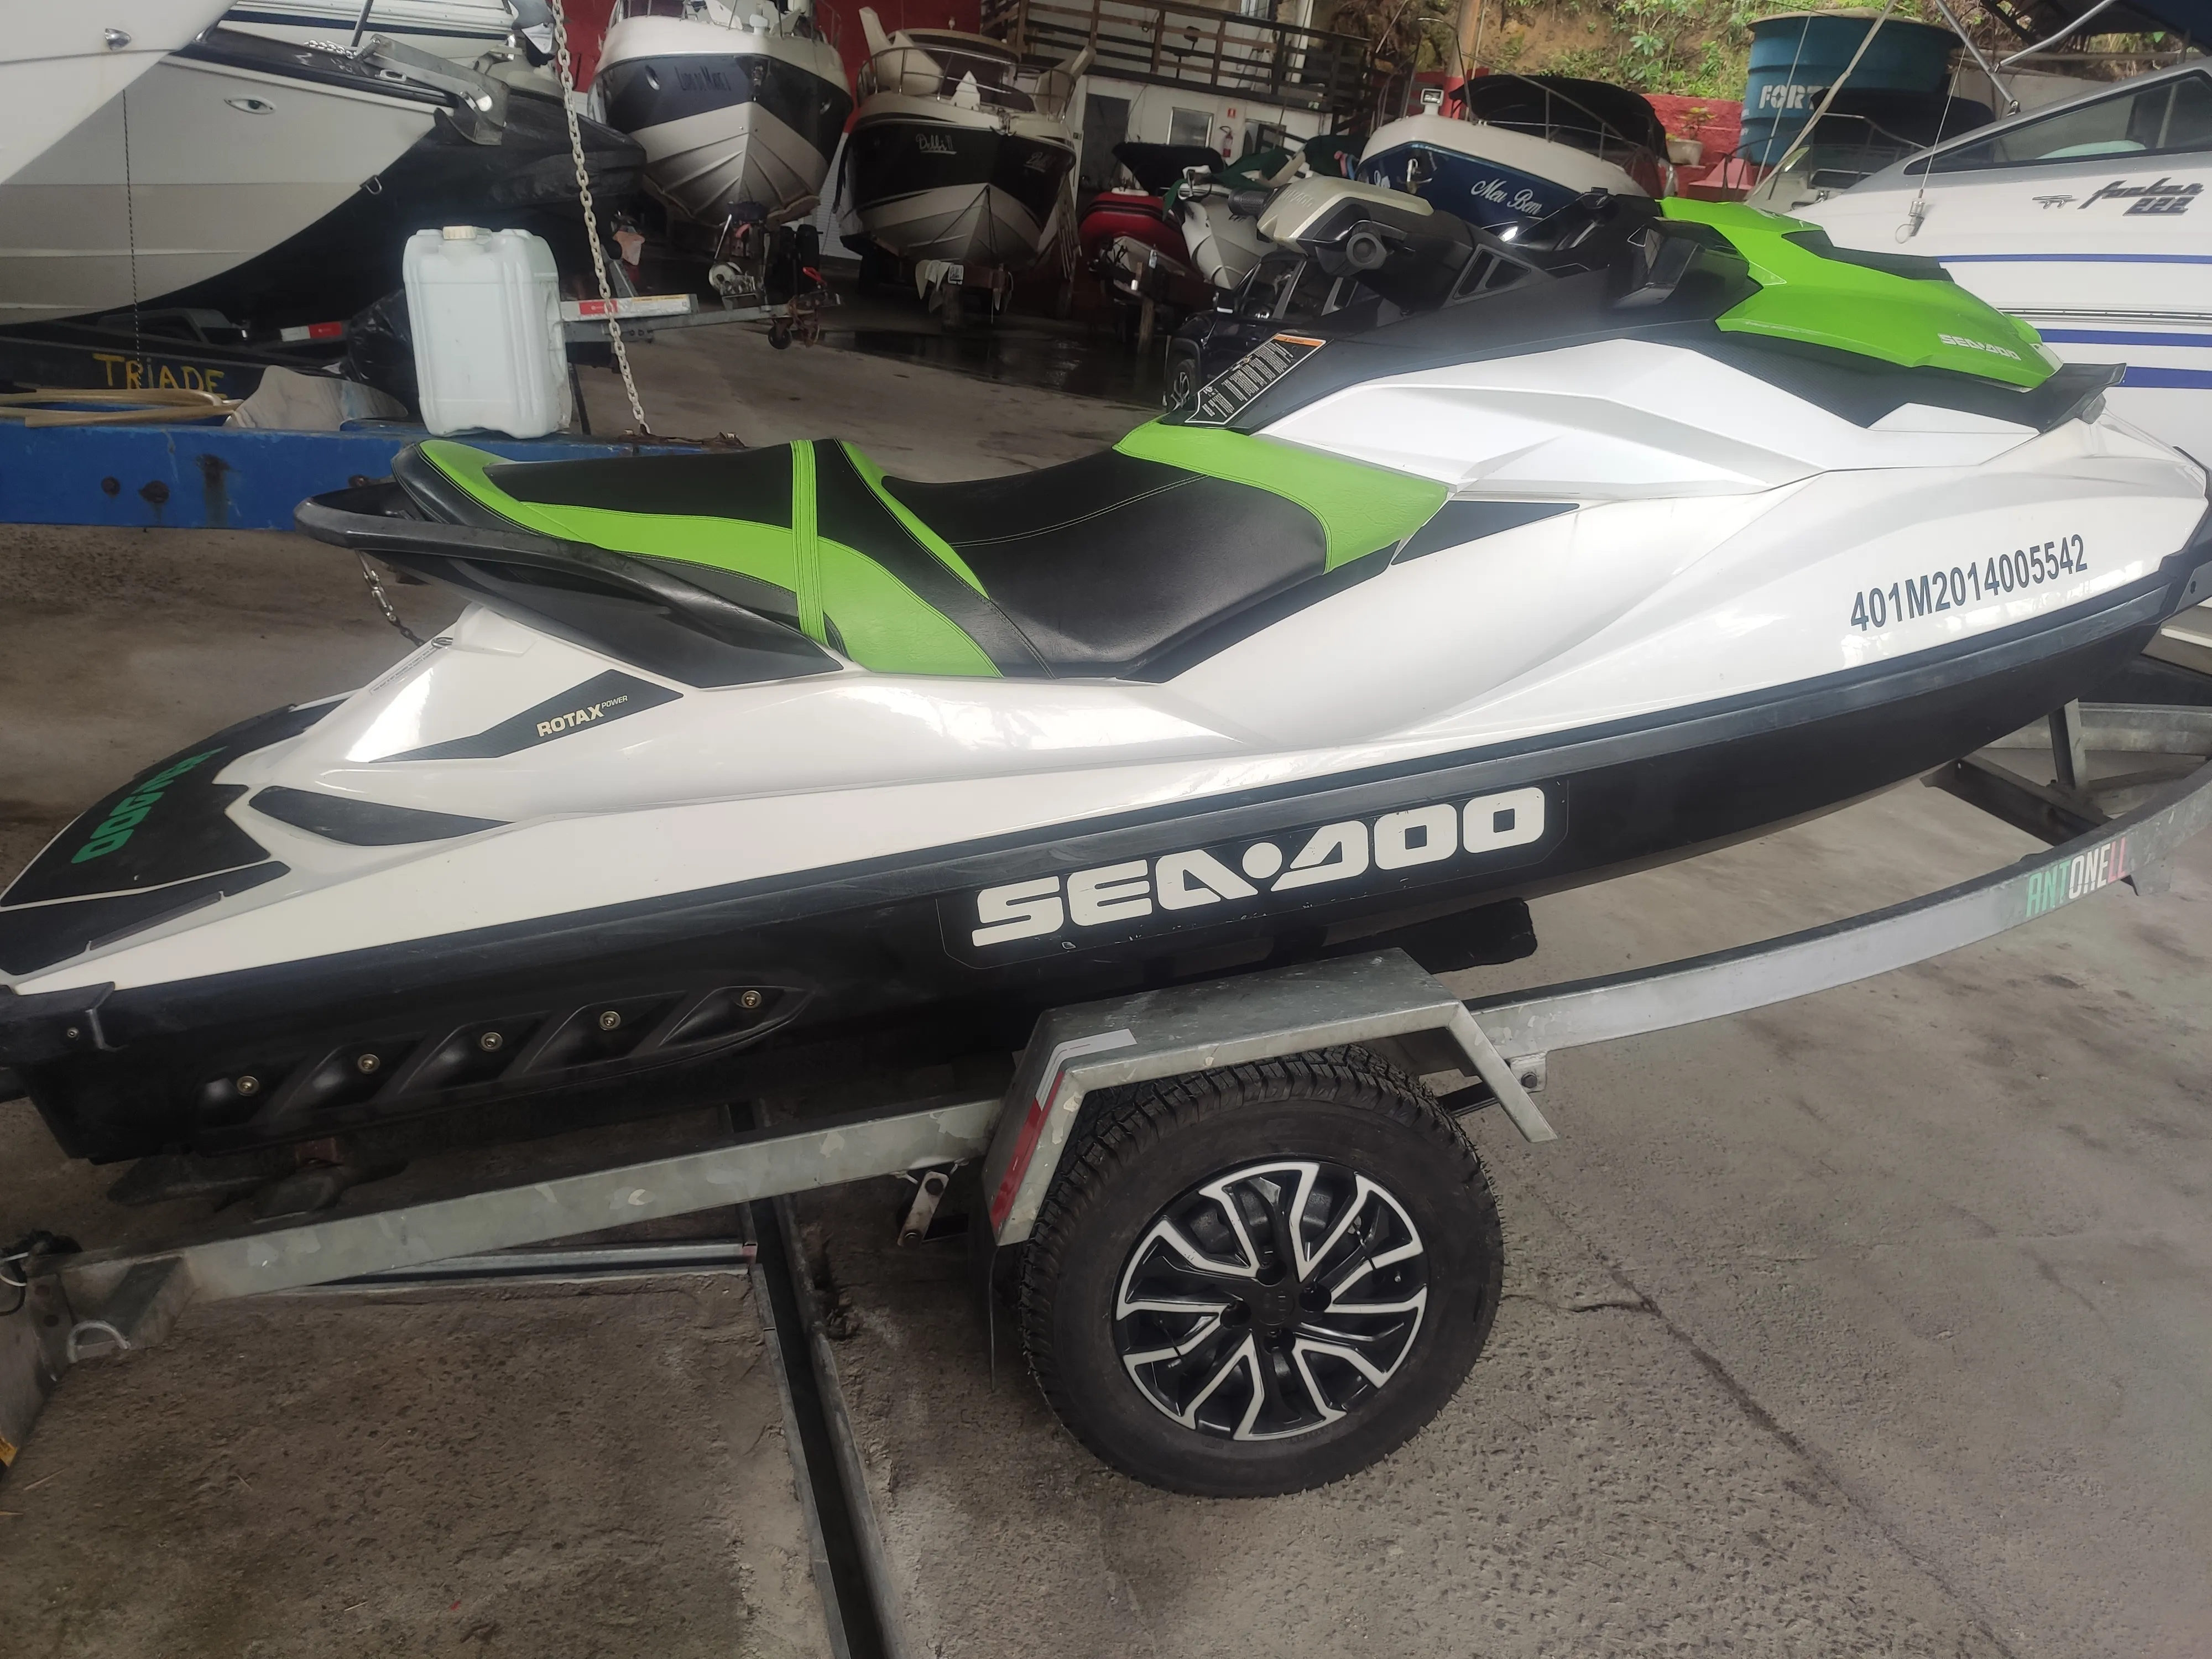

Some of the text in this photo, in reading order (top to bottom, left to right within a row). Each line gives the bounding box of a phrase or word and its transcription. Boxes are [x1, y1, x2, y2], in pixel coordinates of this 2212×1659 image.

[1759, 85, 1831, 110] FORT
[1470, 178, 1542, 215] Meu Bem
[2122, 197, 2195, 216] 222
[1850, 534, 2088, 632] 401M2014005542
[536, 695, 628, 737] ROTAX POWER
[2026, 837, 2126, 917] ANTONELL
